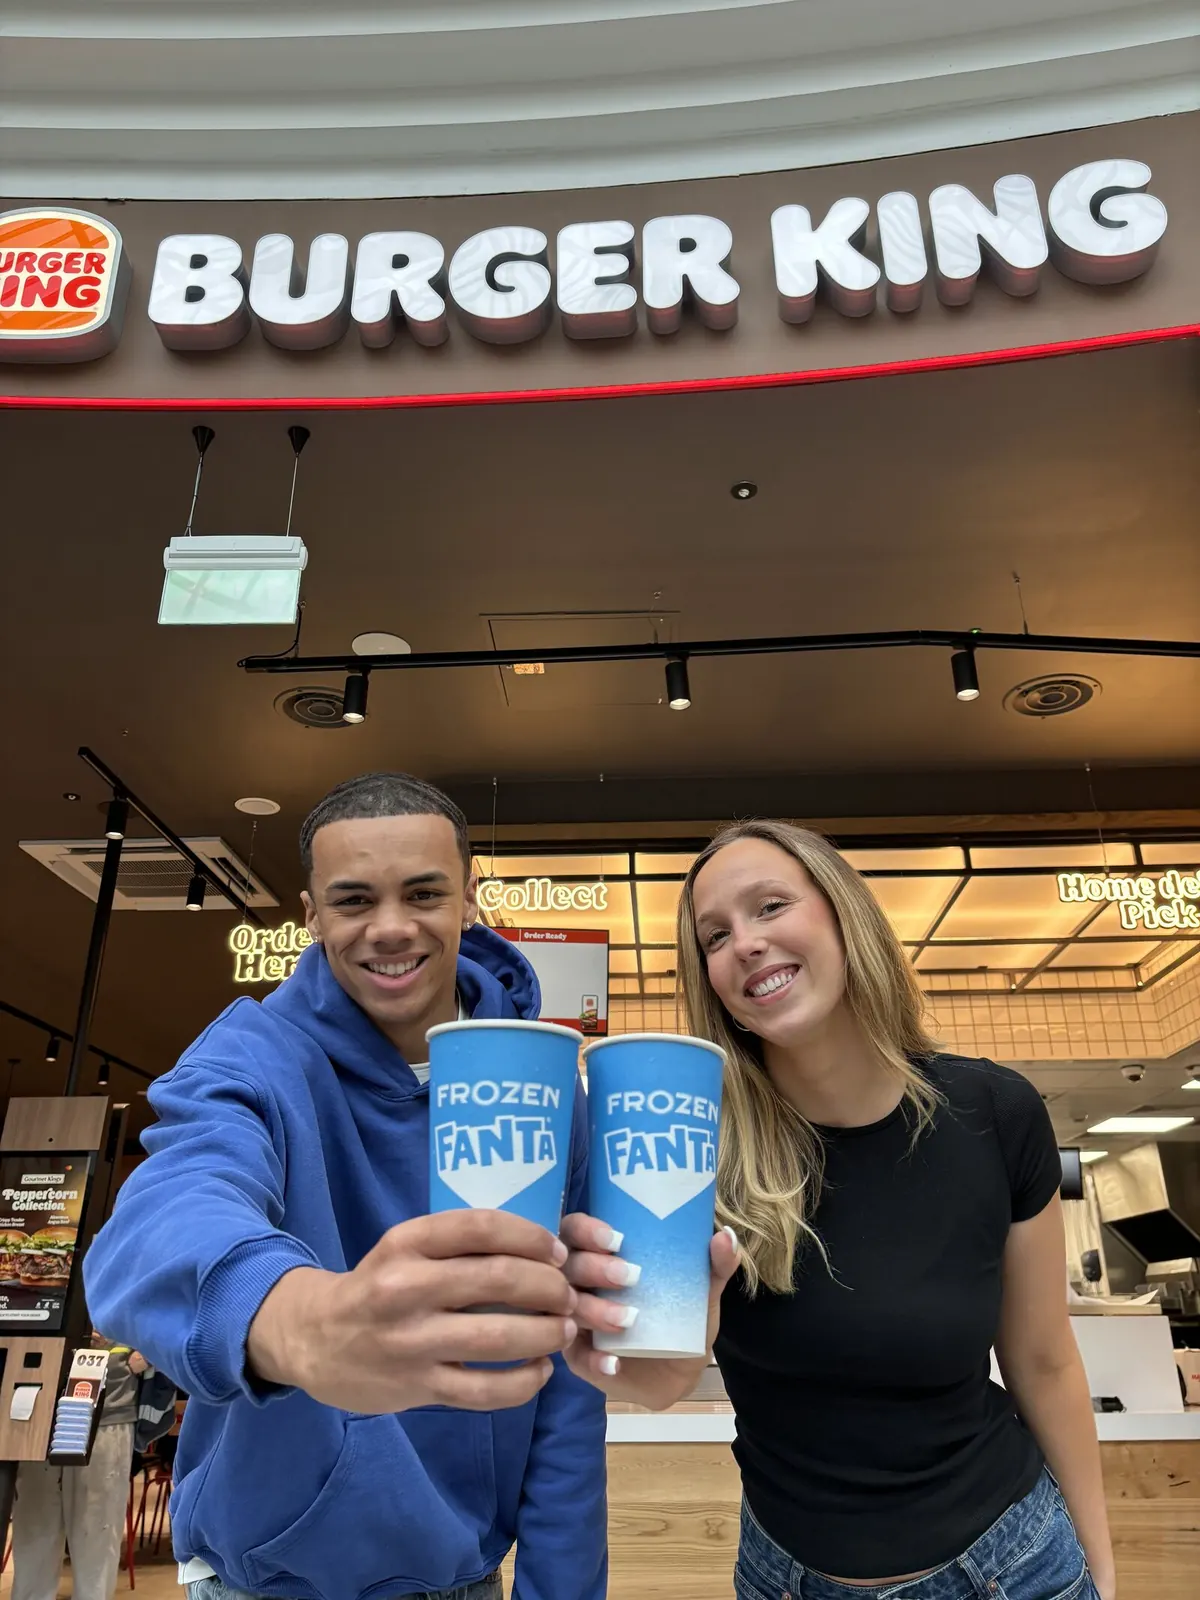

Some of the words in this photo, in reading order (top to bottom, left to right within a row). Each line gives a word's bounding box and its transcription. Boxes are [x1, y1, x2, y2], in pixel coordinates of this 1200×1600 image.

[148, 214, 740, 325] BURGER
[770, 159, 1168, 298] KING
[0, 252, 106, 274] URGER
[0, 275, 101, 308] ING
[476, 878, 608, 911] Collect
[1057, 873, 1156, 902] Home
[1158, 869, 1200, 899] de
[1119, 898, 1200, 929] Pick
[229, 921, 314, 953] Orde
[523, 932, 545, 940] Order
[545, 933, 567, 941] Ready
[234, 951, 300, 982] Her
[436, 1080, 561, 1109] FROZEN
[606, 1090, 720, 1125] FROZEN
[434, 1115, 557, 1174] FANTA
[604, 1124, 716, 1177] FANTA
[2, 1187, 78, 1203] Peppercorn
[77, 1354, 105, 1367] 037
